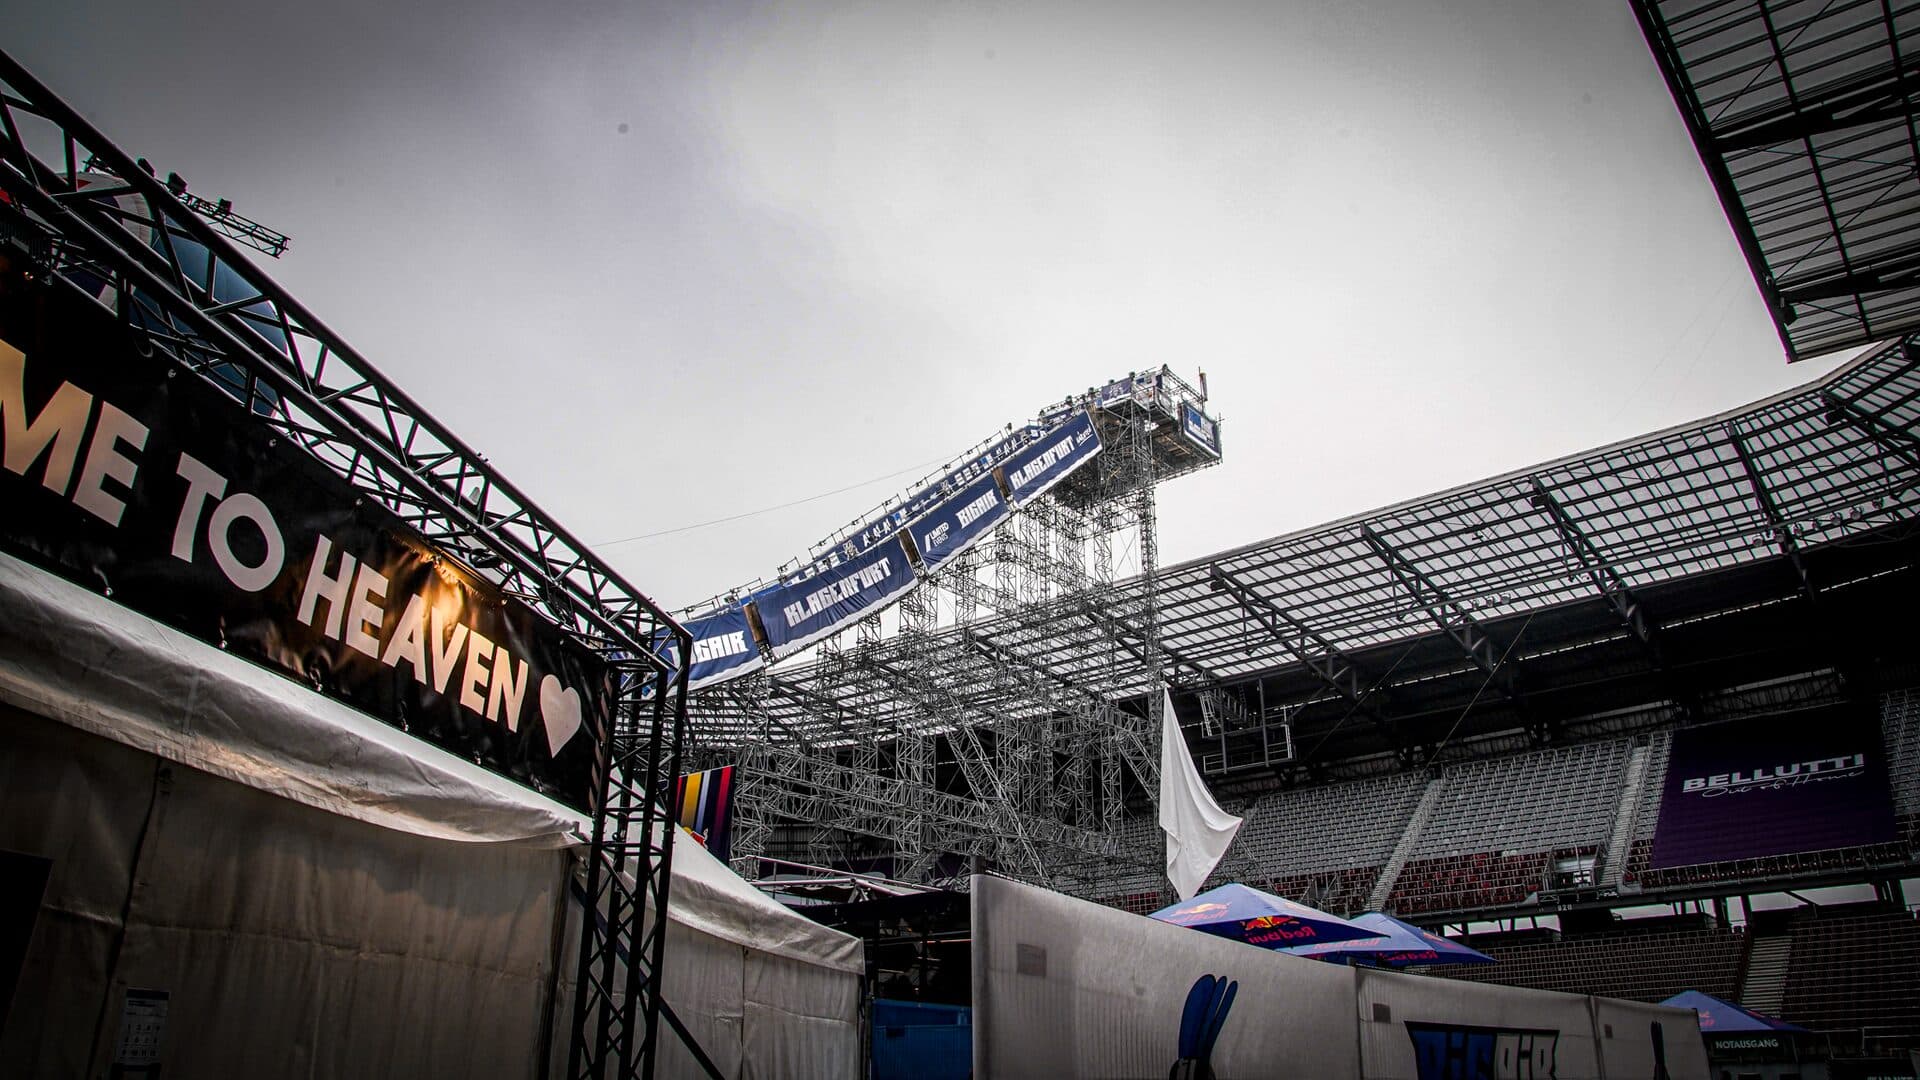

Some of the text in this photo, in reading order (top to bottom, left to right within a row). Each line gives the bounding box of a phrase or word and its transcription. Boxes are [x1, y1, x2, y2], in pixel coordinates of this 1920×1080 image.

[1010, 435, 1076, 490] KLAGENFURT
[170, 452, 286, 592] TO
[296, 534, 530, 733] HEAVEN
[783, 556, 892, 628] KLAGENFURT
[1683, 753, 1864, 791] BELLUTTI
[1715, 1038, 1780, 1049] NOTAUSGANG
